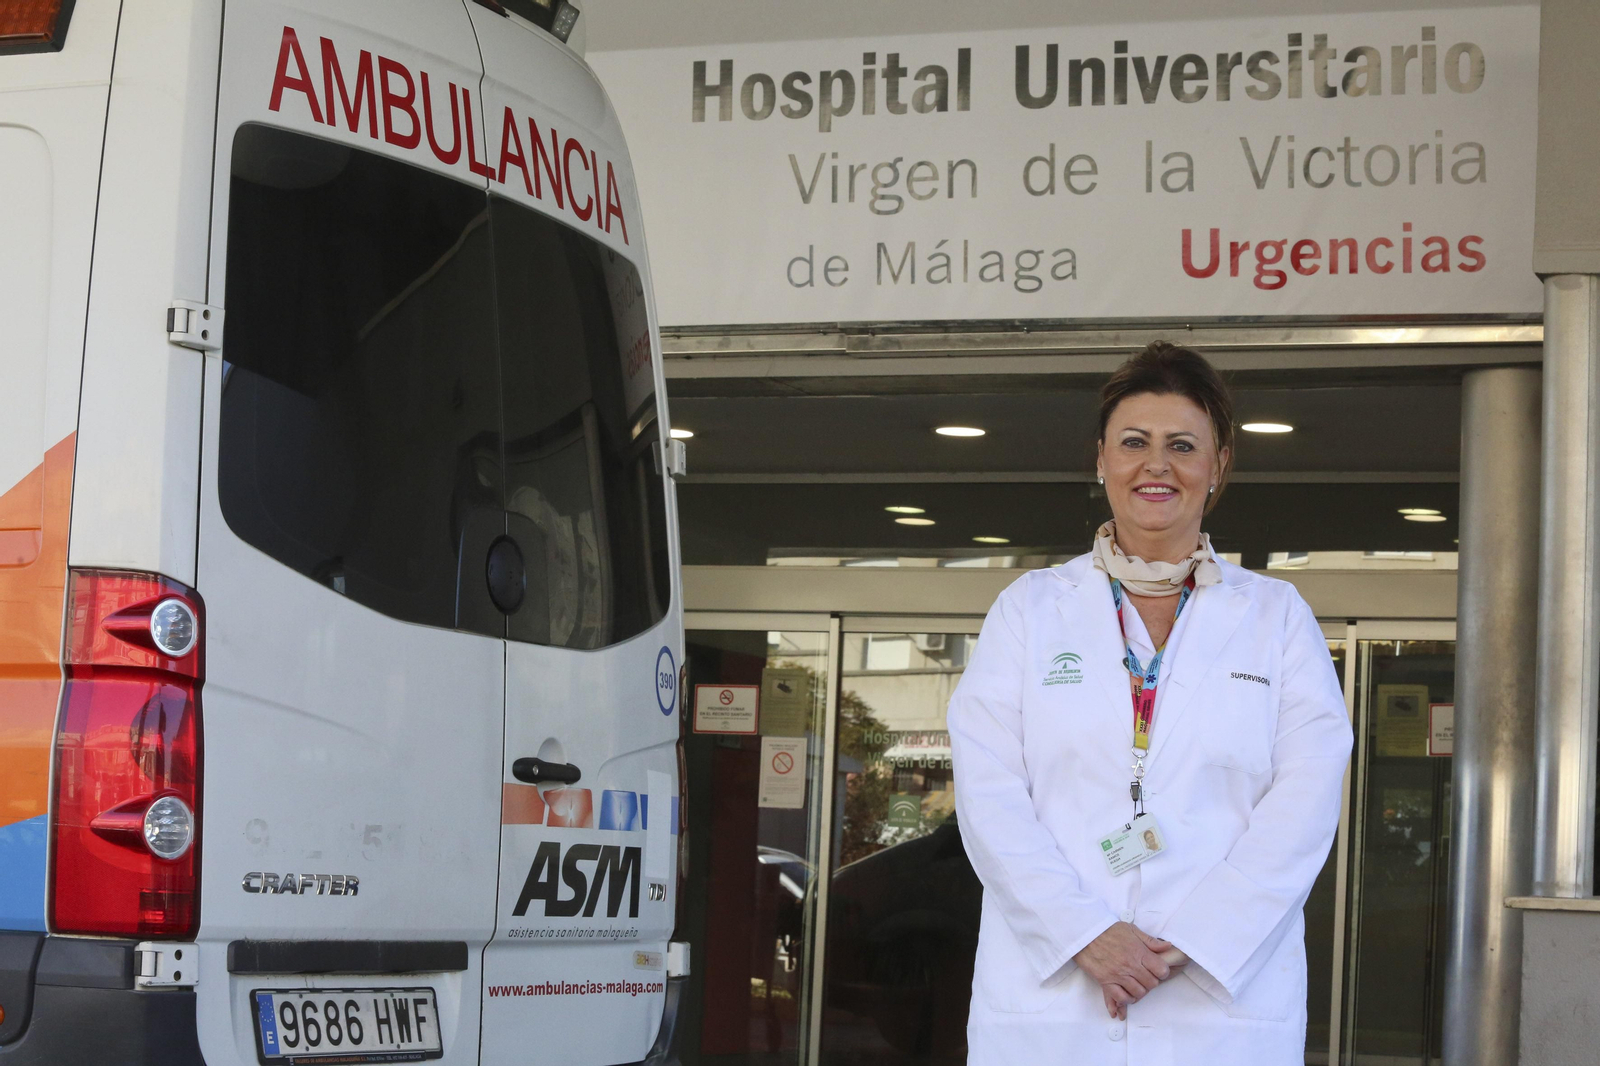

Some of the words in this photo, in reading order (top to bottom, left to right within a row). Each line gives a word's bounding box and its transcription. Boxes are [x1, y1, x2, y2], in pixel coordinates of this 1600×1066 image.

[691, 48, 971, 131] Hospital
[1015, 26, 1487, 109] Universitario
[268, 25, 629, 245] AMBULANCIA
[789, 151, 979, 215] Virgen
[1023, 145, 1098, 196] de
[1145, 142, 1195, 194] la
[1240, 130, 1489, 191] Victoria
[786, 246, 850, 289] de
[876, 238, 1078, 294] Málaga
[1180, 224, 1487, 290] Urgencias
[660, 672, 673, 690] 390
[863, 729, 922, 747] Hospital
[918, 753, 935, 769] de
[242, 871, 360, 896] CRAFTER
[512, 841, 642, 918] ASM
[648, 883, 666, 901] TDI
[508, 926, 555, 939] asistencia
[556, 926, 595, 938] sanitaria
[596, 925, 639, 941] malagueña
[488, 979, 664, 998] www.ambulancias-malaga.com
[279, 999, 363, 1048] 9686
[374, 998, 428, 1044] HWF
[266, 1031, 275, 1044] E
